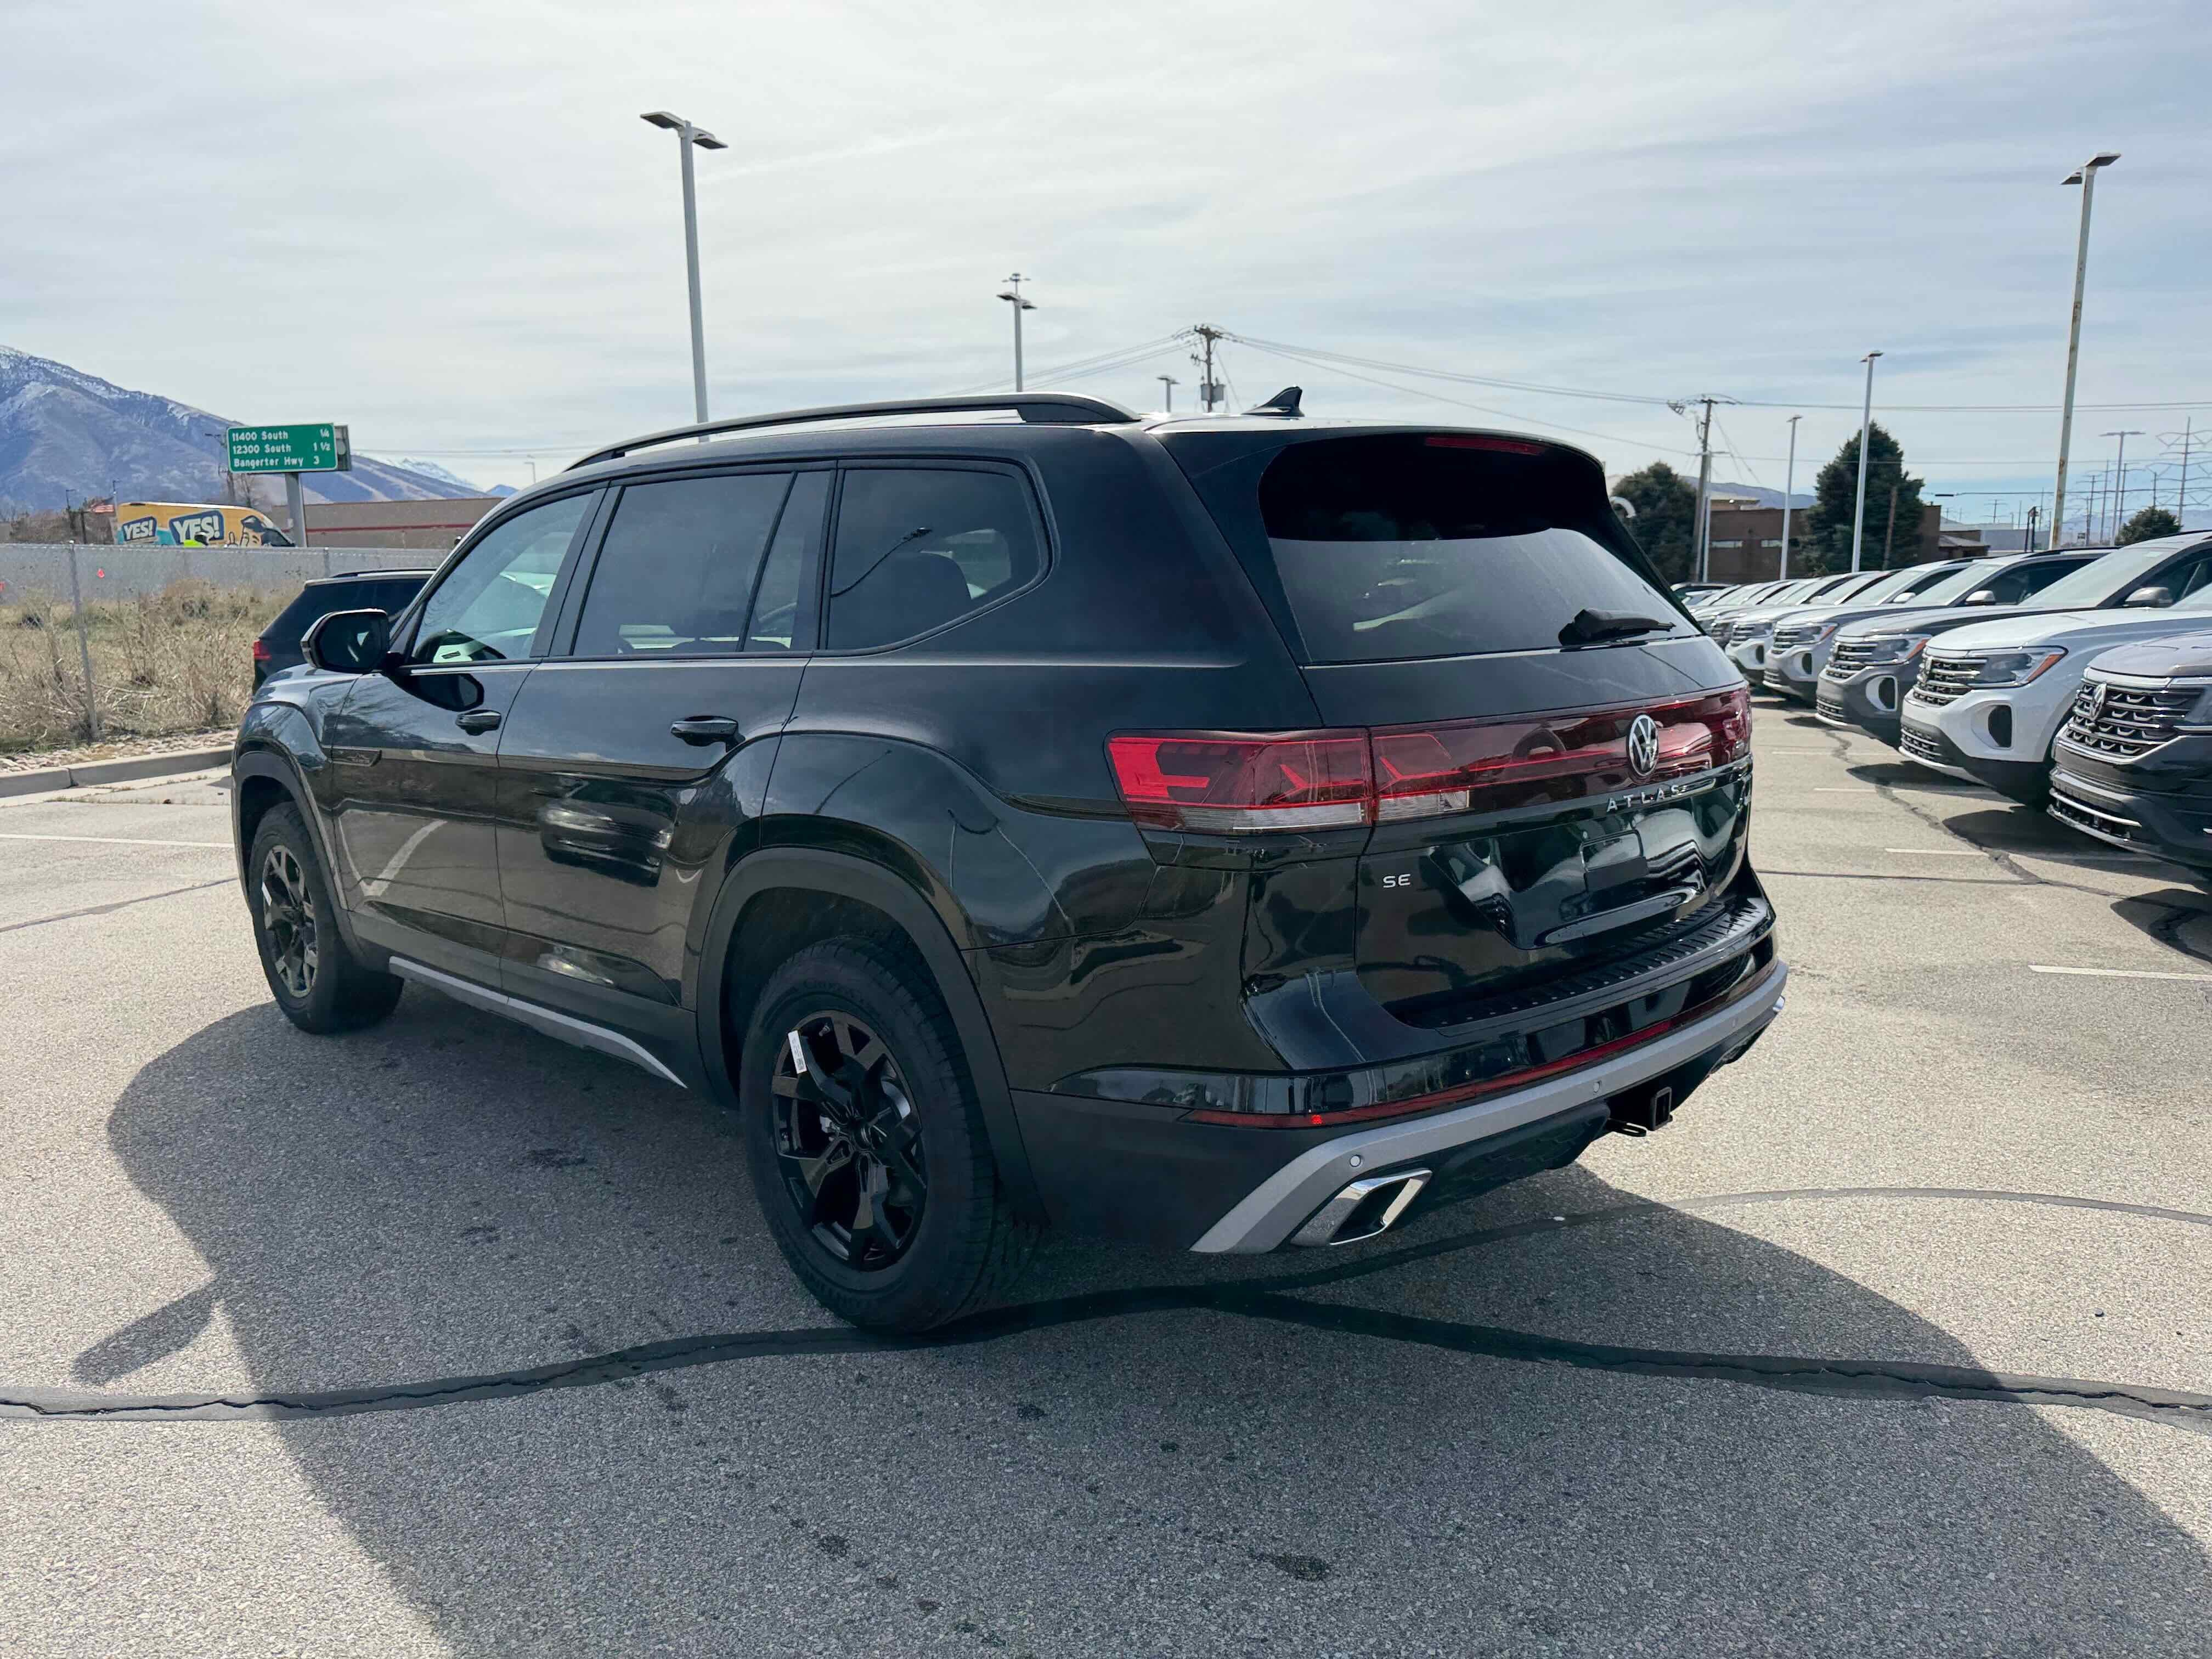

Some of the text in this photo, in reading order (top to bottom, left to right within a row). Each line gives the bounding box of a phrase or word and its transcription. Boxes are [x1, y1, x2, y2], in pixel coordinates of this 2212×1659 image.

[232, 431, 257, 442] 11400
[262, 430, 289, 440] South
[233, 444, 260, 455] 12300
[264, 443, 291, 453] South
[234, 456, 320, 469] Bangerter Hwy 3
[123, 520, 154, 540] YES!
[1606, 784, 1683, 812] ATLAS
[1383, 873, 1410, 888] SE
